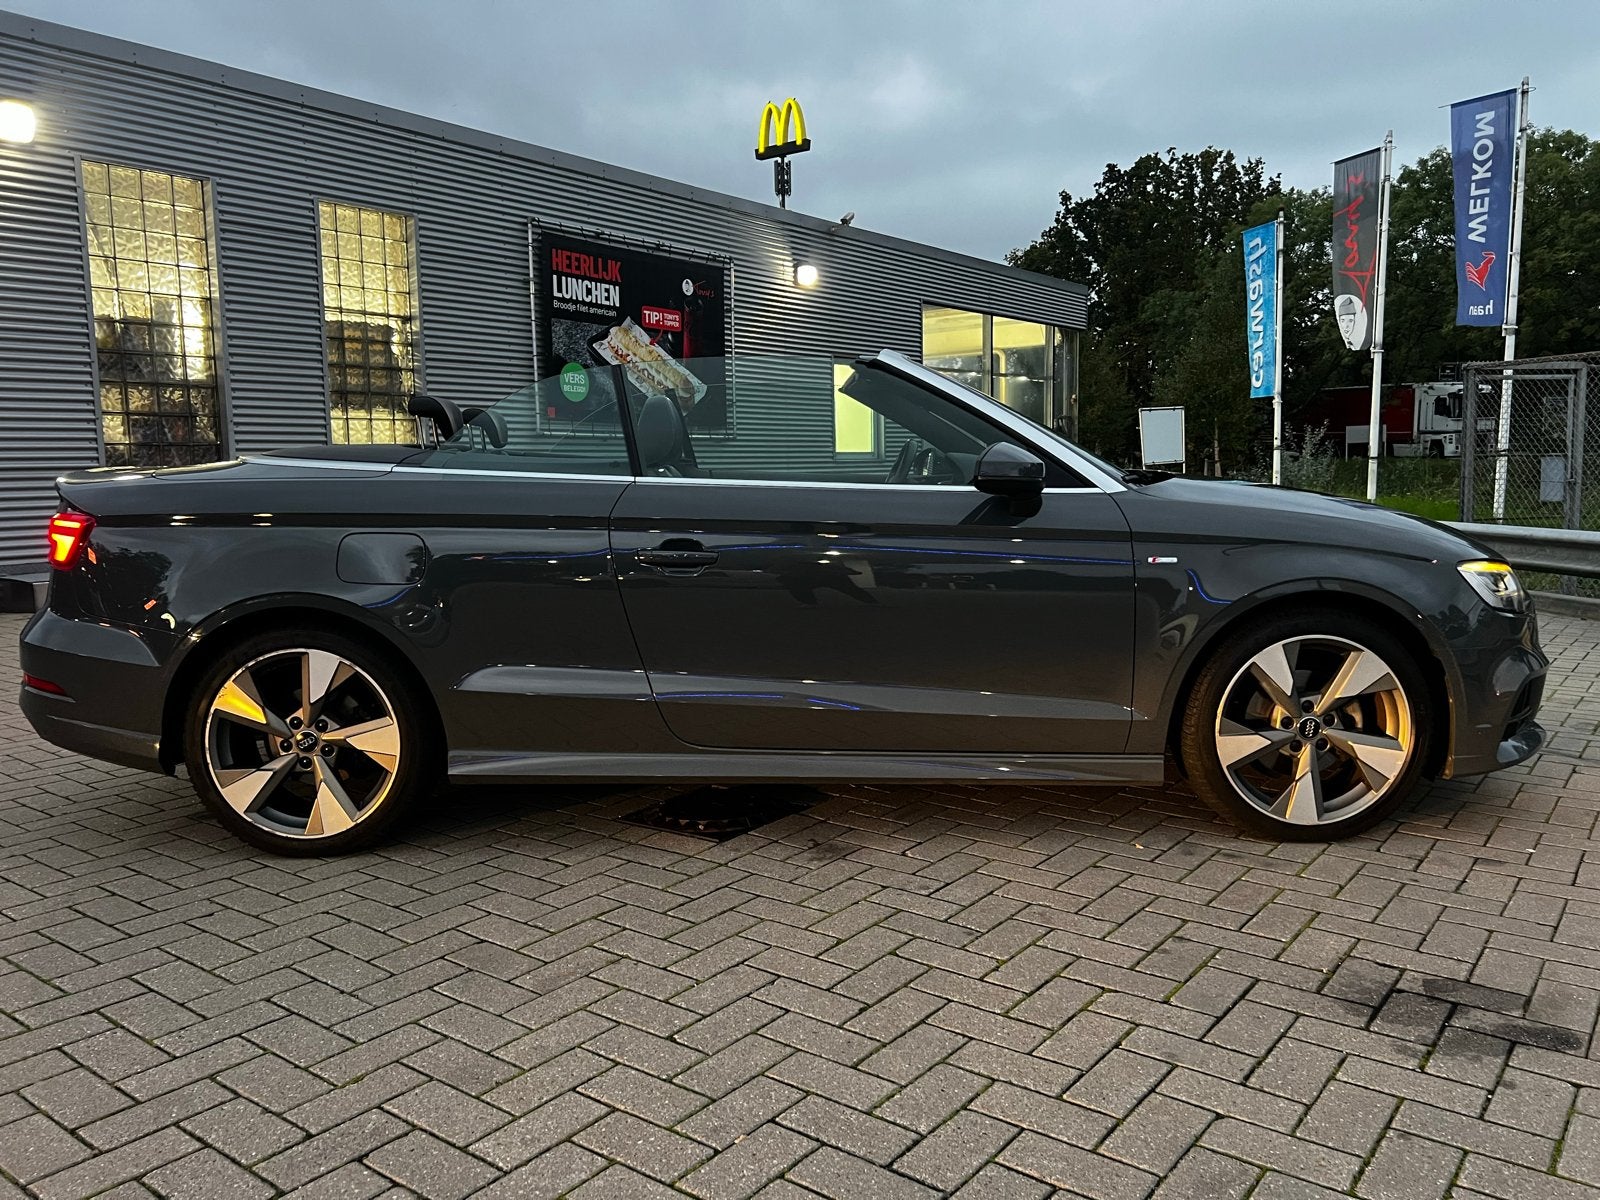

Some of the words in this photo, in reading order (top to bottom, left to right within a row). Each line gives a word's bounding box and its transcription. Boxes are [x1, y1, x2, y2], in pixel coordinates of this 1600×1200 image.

[551, 248, 622, 283] HEERLIJK
[552, 274, 620, 307] LUNCHEN
[553, 299, 576, 312] Broodje
[577, 303, 589, 313] filet
[589, 307, 617, 317] americain
[643, 310, 663, 325] TIP!
[663, 313, 680, 322] TONY'S
[663, 320, 680, 328] TOPPER
[563, 371, 585, 385] VERS
